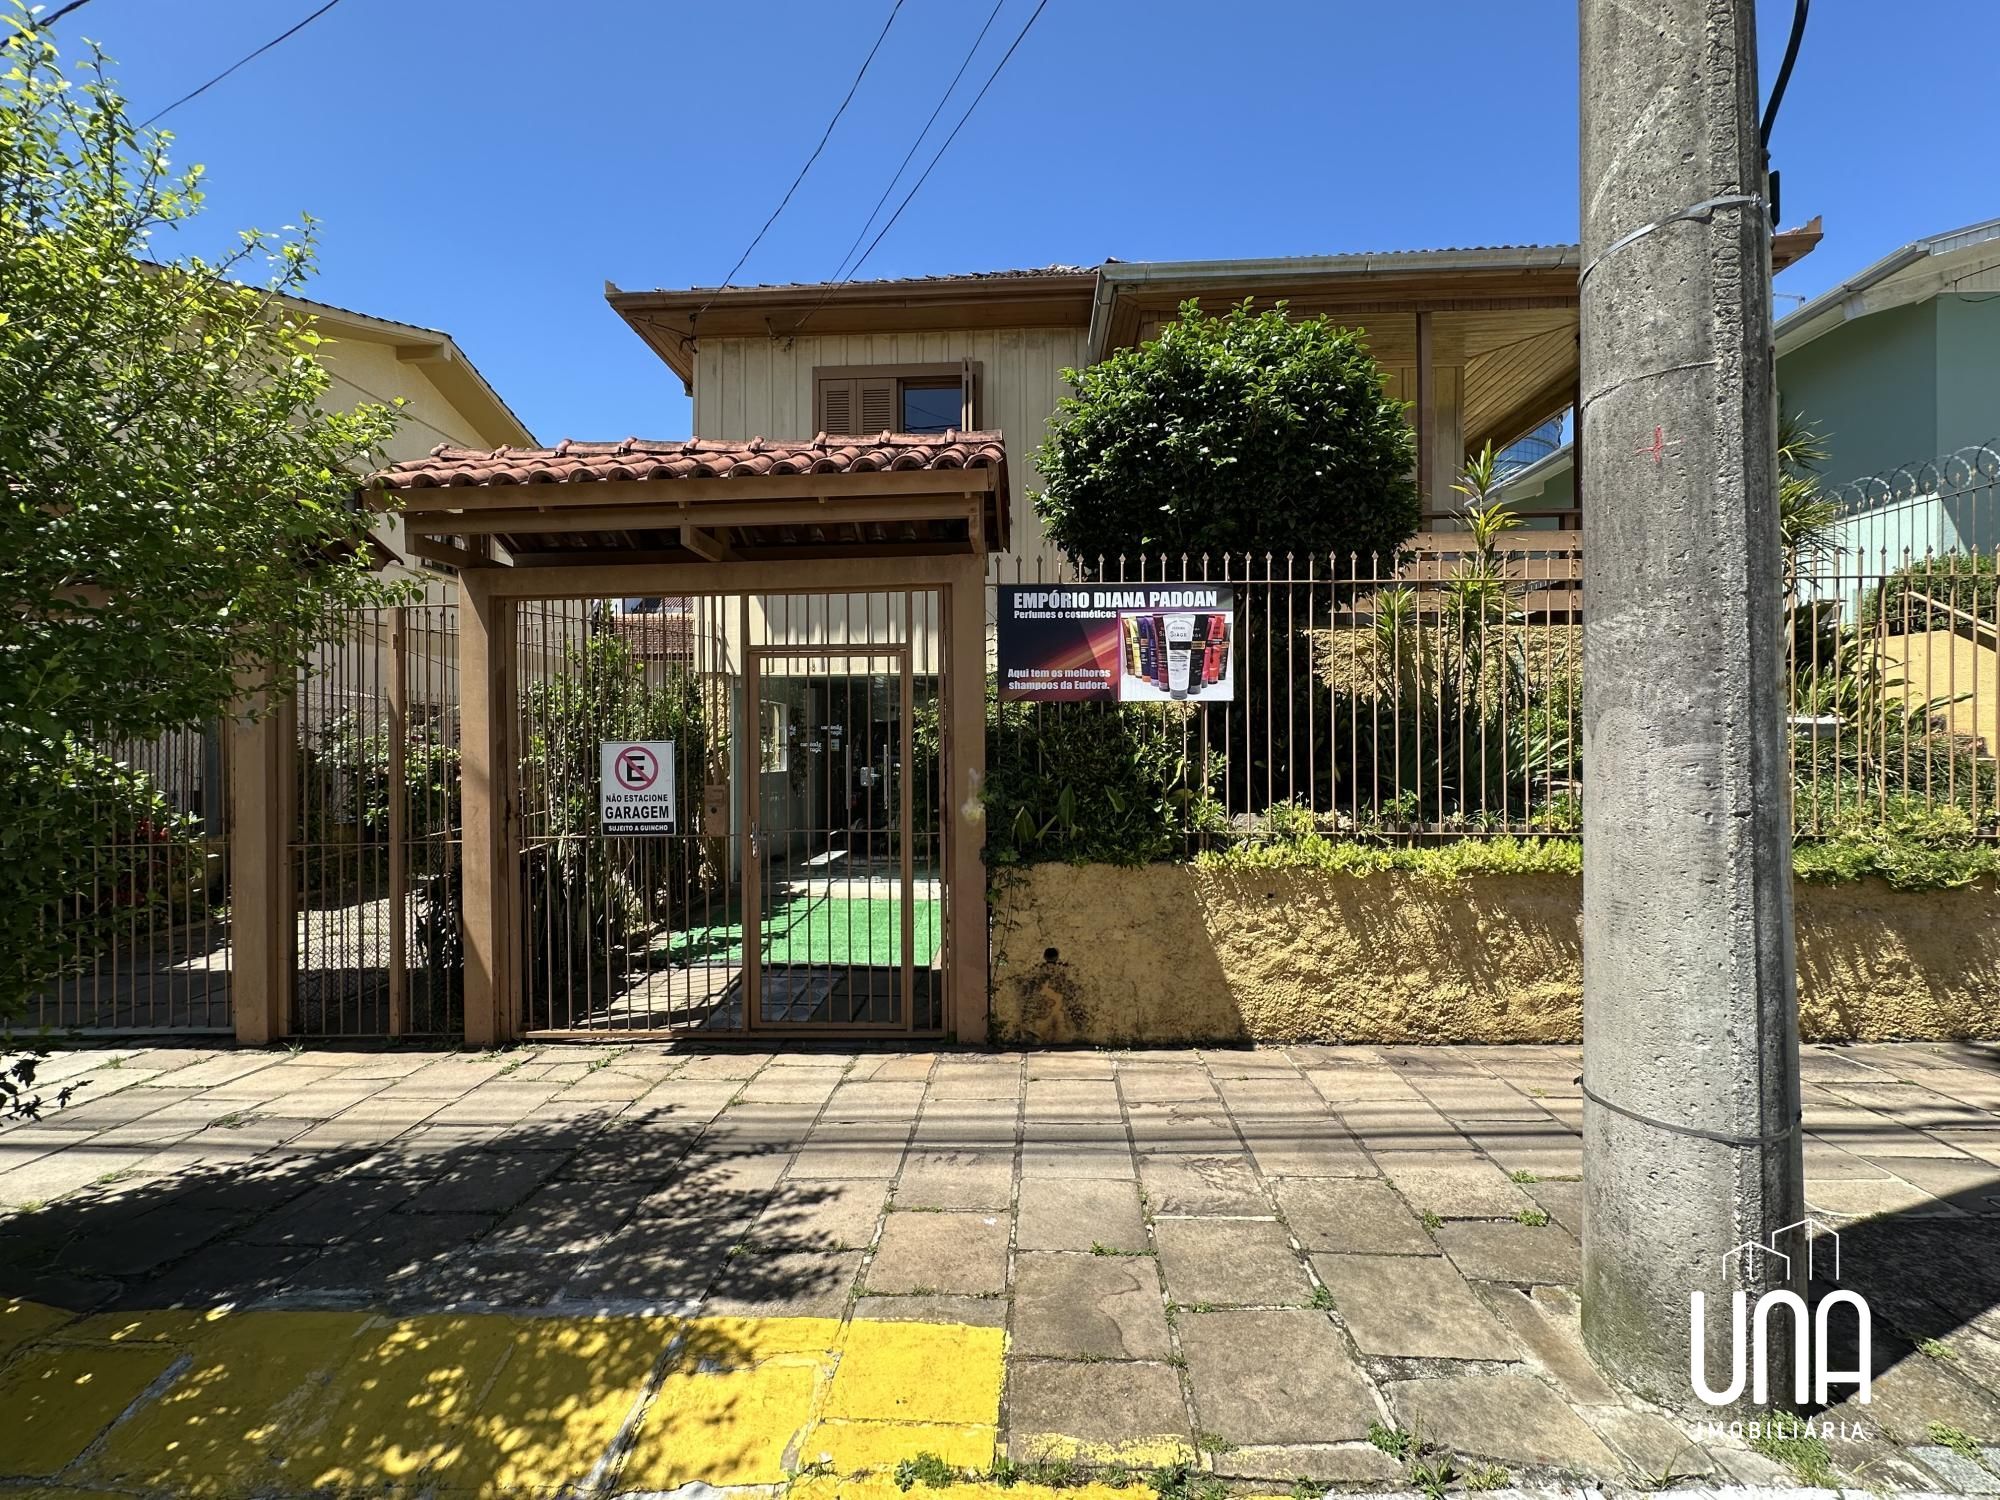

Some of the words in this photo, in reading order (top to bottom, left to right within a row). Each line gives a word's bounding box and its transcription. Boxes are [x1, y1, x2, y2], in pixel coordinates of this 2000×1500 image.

[1013, 590, 1090, 608] EMPÓRIO
[1093, 591, 1146, 608] DIANA
[1149, 590, 1217, 607] PADOAN
[1014, 610, 1057, 619] Perfumes
[1057, 611, 1063, 619] e
[1064, 609, 1117, 619] cosméticos
[1007, 668, 1029, 679] Aqui
[1030, 668, 1050, 678] tem
[1051, 669, 1063, 678] os
[1064, 668, 1111, 678] melhores
[1008, 680, 1059, 690] shampoos
[1060, 680, 1073, 690] da
[1074, 680, 1110, 690] Eudora.
[606, 793, 622, 803] NÃO
[624, 793, 668, 803] ESTACIONE
[604, 805, 669, 820] GARAGEM
